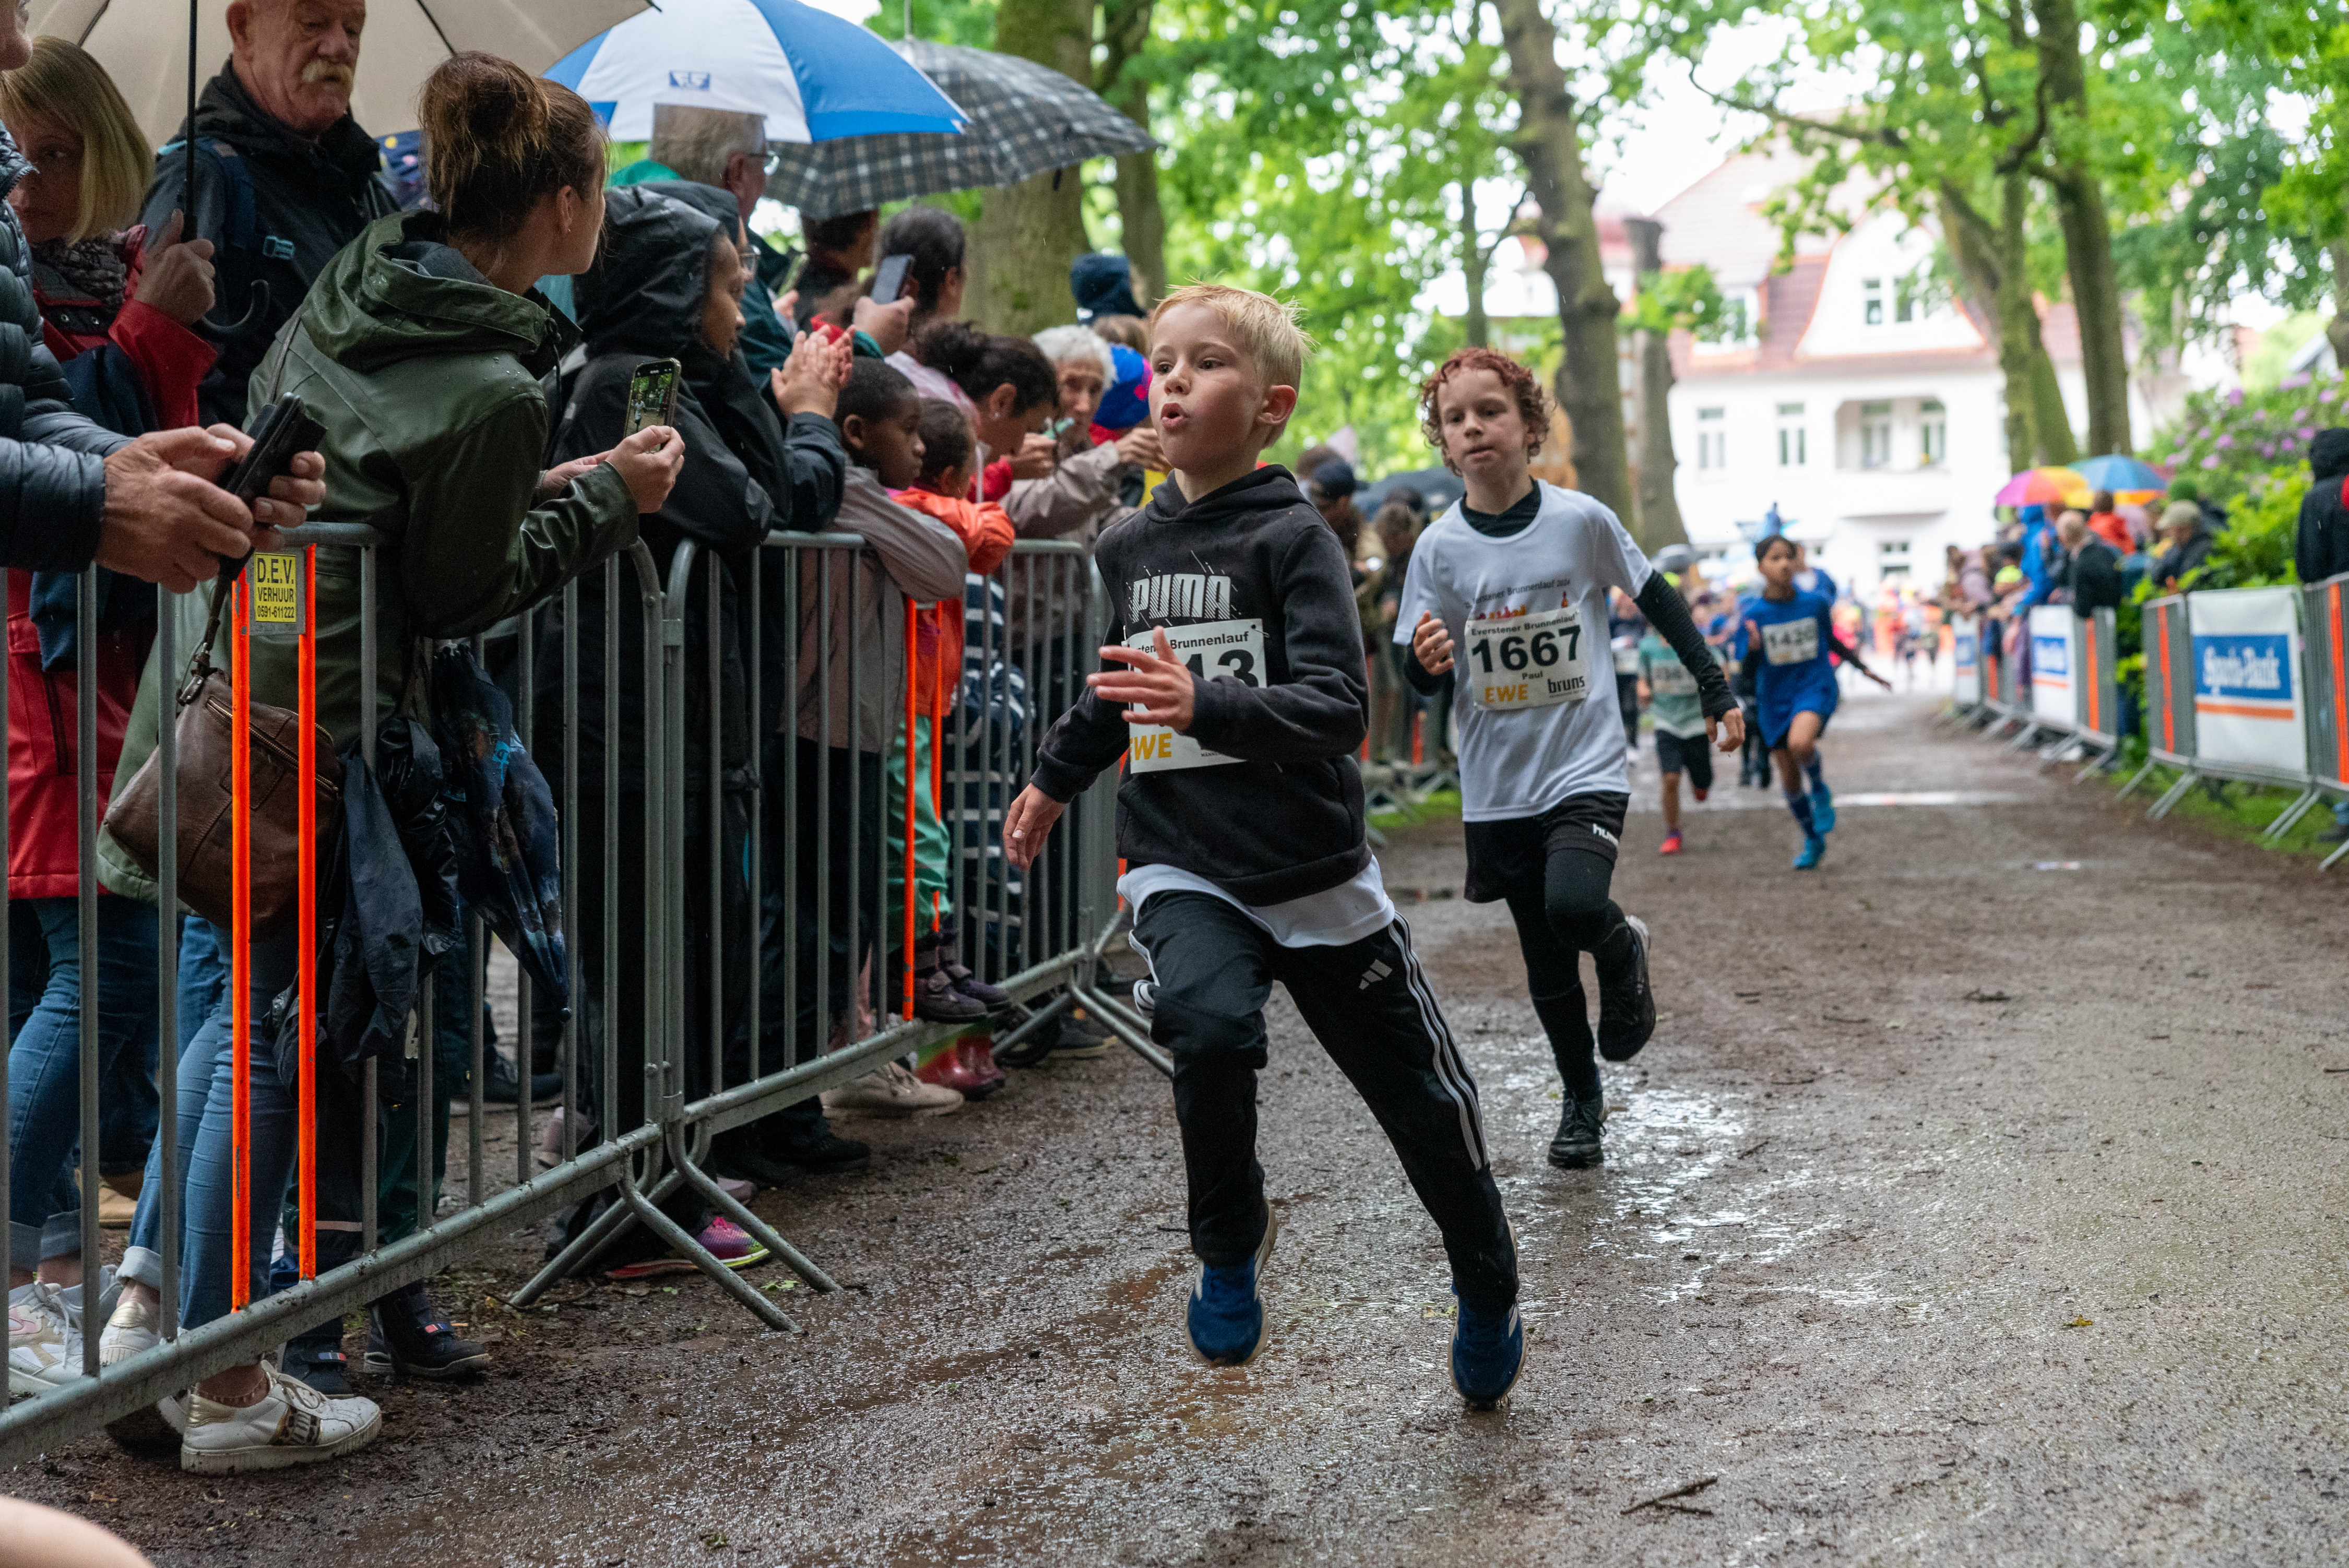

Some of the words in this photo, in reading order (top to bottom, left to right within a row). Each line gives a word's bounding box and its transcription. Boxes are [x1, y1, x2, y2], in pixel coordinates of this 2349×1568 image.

[257, 557, 294, 584] D.E.V.
[258, 587, 294, 602] VERHUUR
[1506, 579, 1555, 596] Brunnenlauf
[1132, 573, 1231, 623] PUMA
[257, 605, 294, 618] 0591-611222
[1472, 626, 1521, 636] Everstener
[1524, 613, 1575, 630] Brunnenlauf
[1170, 631, 1249, 649] Brunnenlauf
[1471, 624, 1581, 673] 1667
[1522, 671, 1543, 680] Paul
[1485, 684, 1528, 703] EWE
[1547, 675, 1585, 693] bruns
